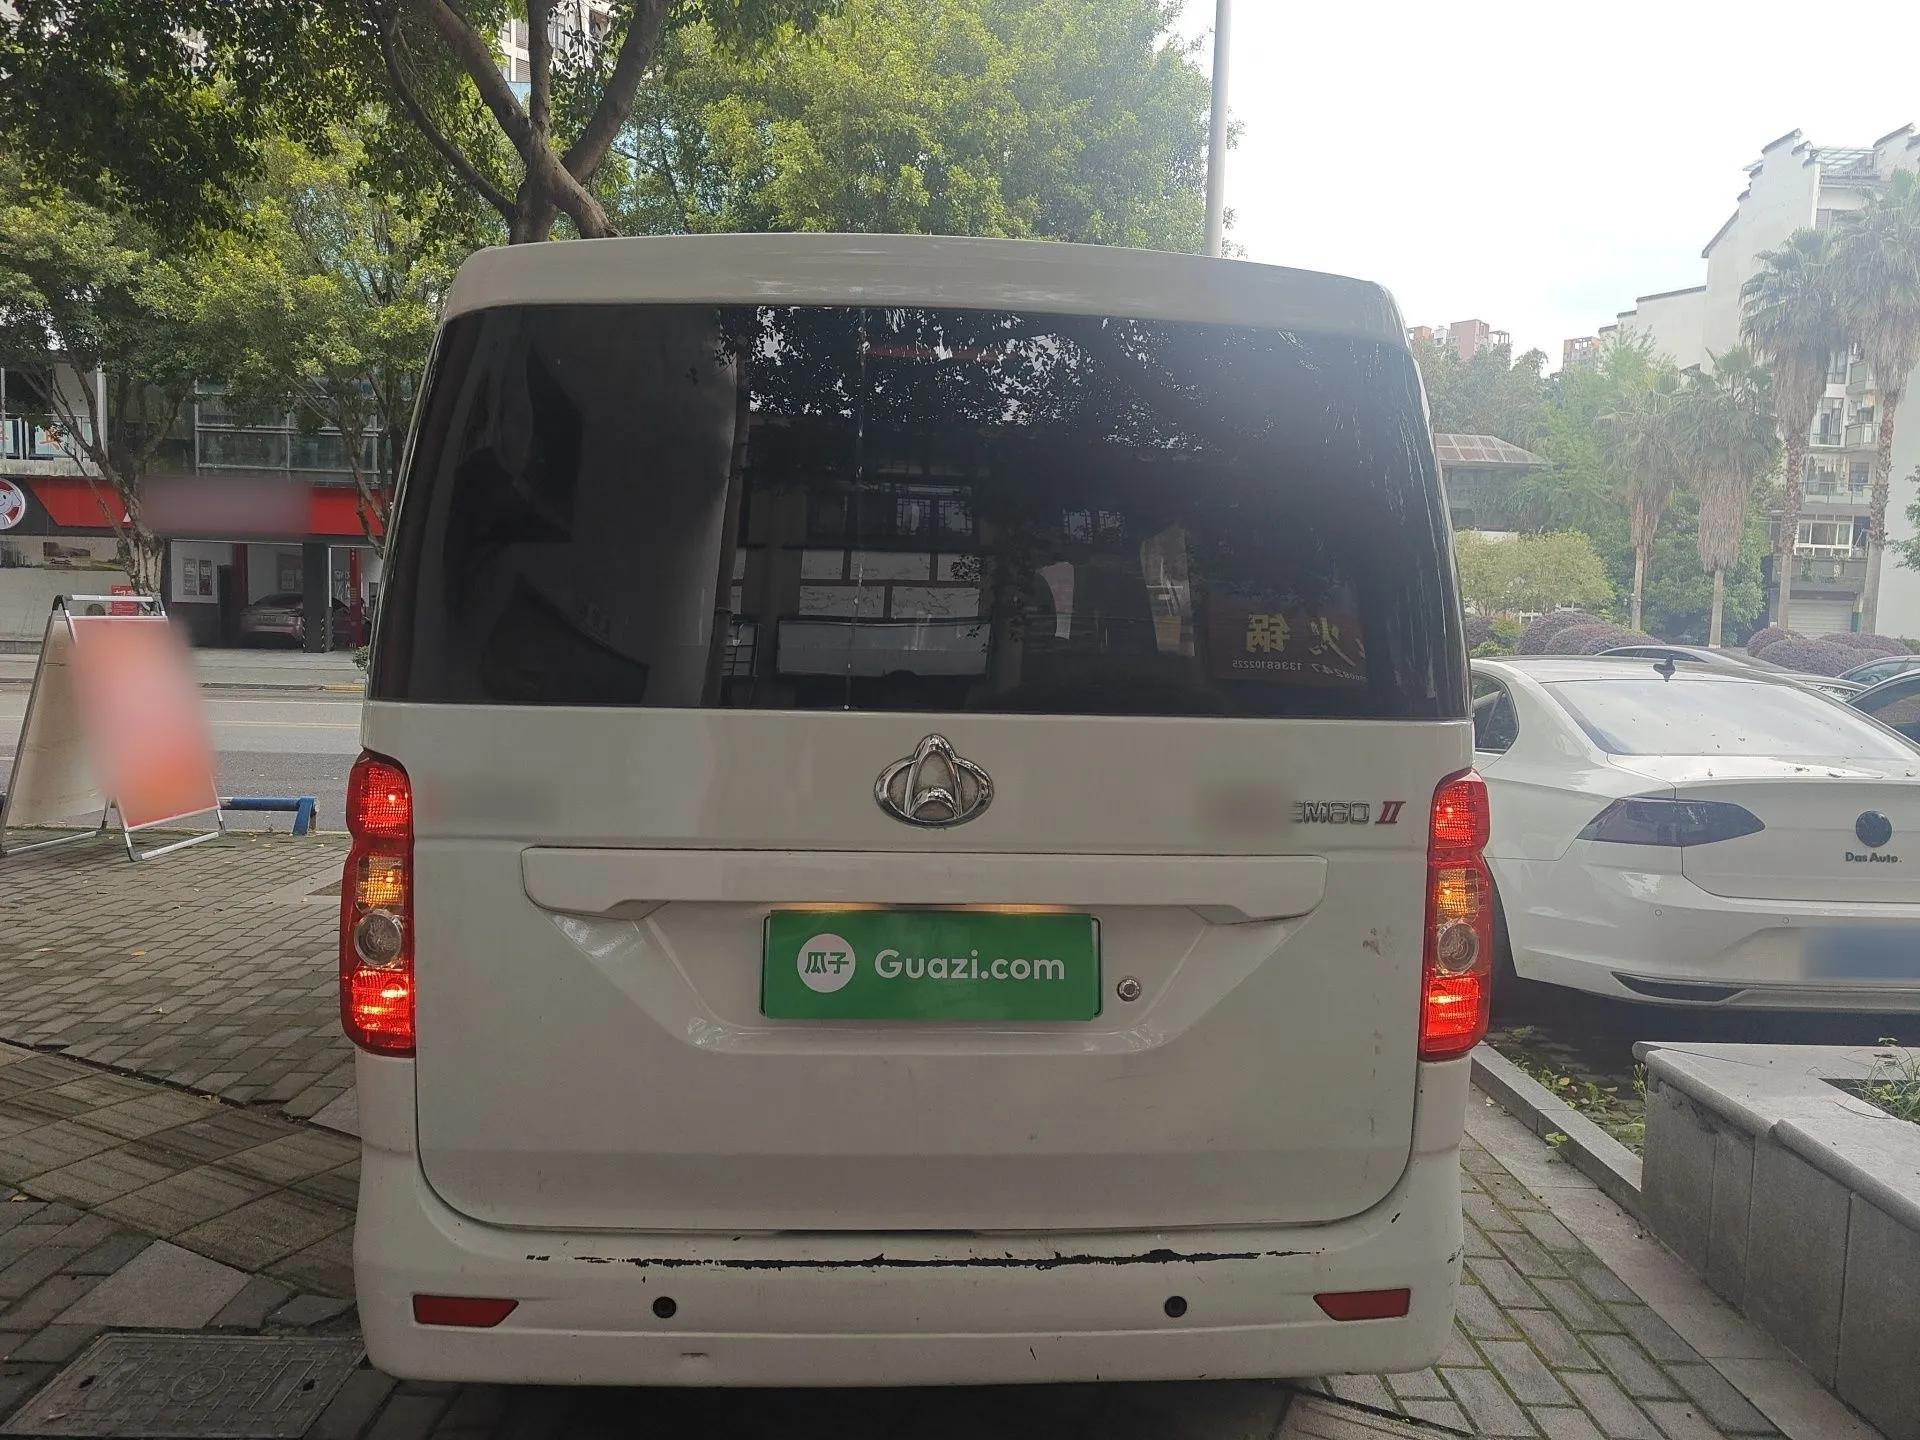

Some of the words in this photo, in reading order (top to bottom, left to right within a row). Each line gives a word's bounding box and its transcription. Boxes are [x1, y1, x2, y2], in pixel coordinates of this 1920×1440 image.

[1375, 801, 1406, 825] II
[1845, 851, 1868, 863] Das
[804, 951, 850, 975] 瓜子
[874, 949, 1065, 980] Guazi.com
